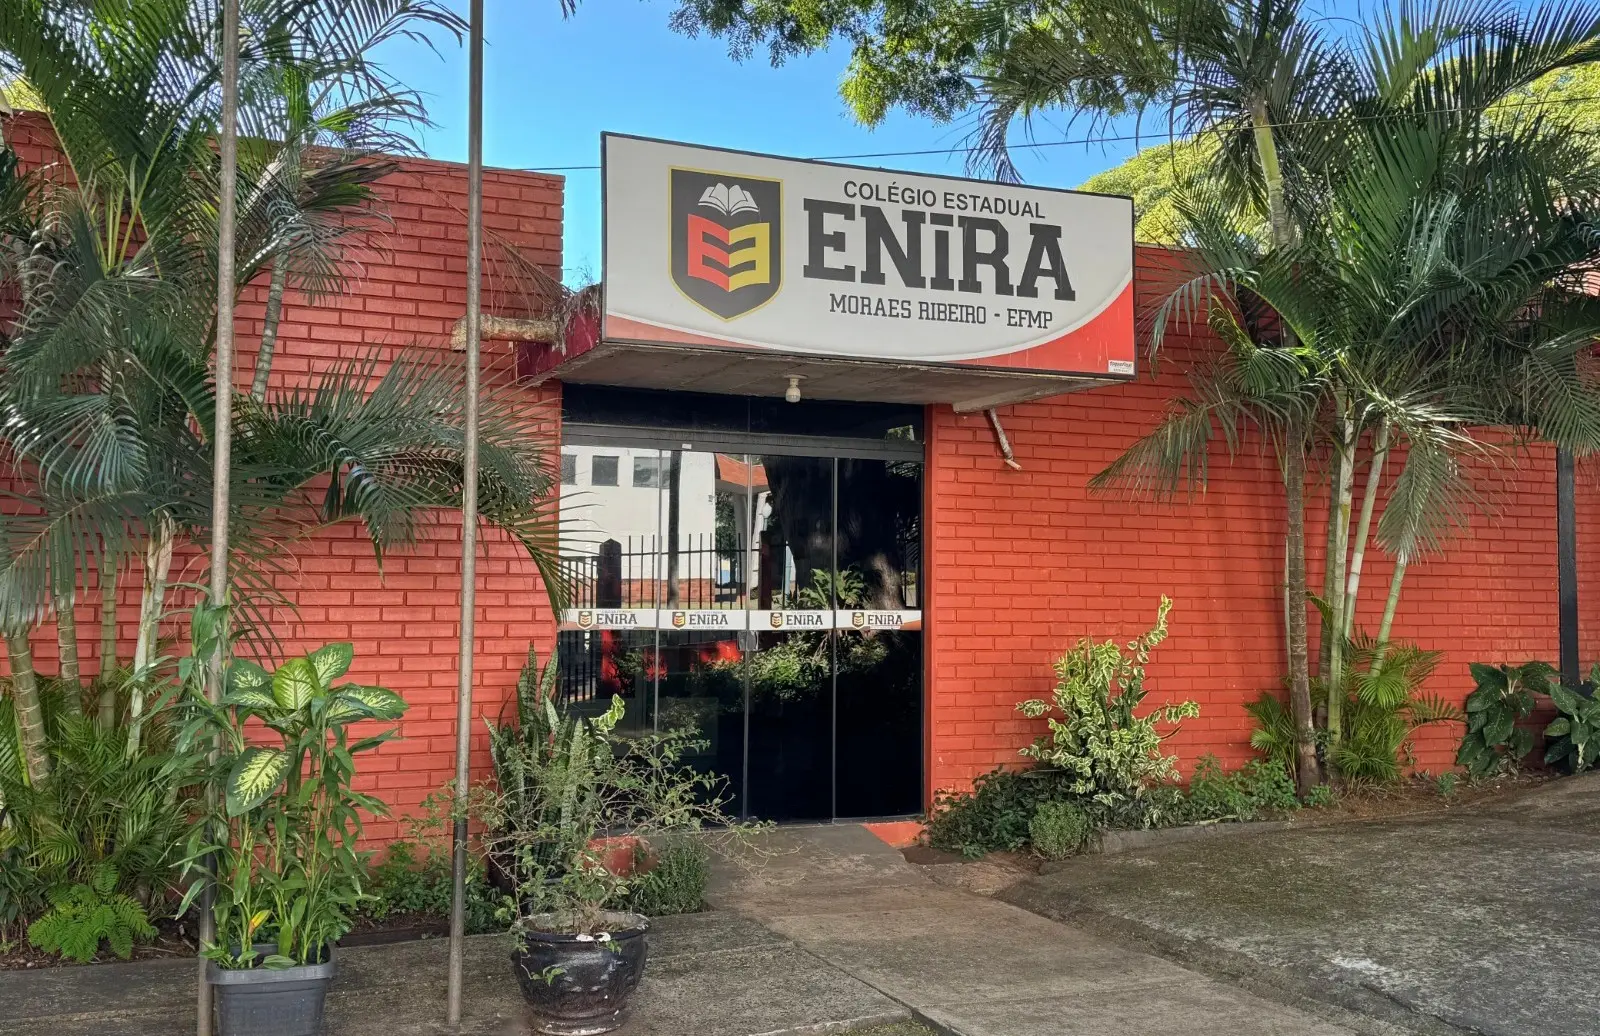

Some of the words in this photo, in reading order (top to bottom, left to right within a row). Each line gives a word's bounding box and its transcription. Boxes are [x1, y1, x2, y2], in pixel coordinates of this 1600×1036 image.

[844, 180, 937, 207] COLÉGIO
[943, 192, 1046, 219] ESTADUAL
[829, 293, 912, 320] MORAES
[918, 301, 986, 325] RIBEIRO
[1006, 308, 1053, 330] EFMP
